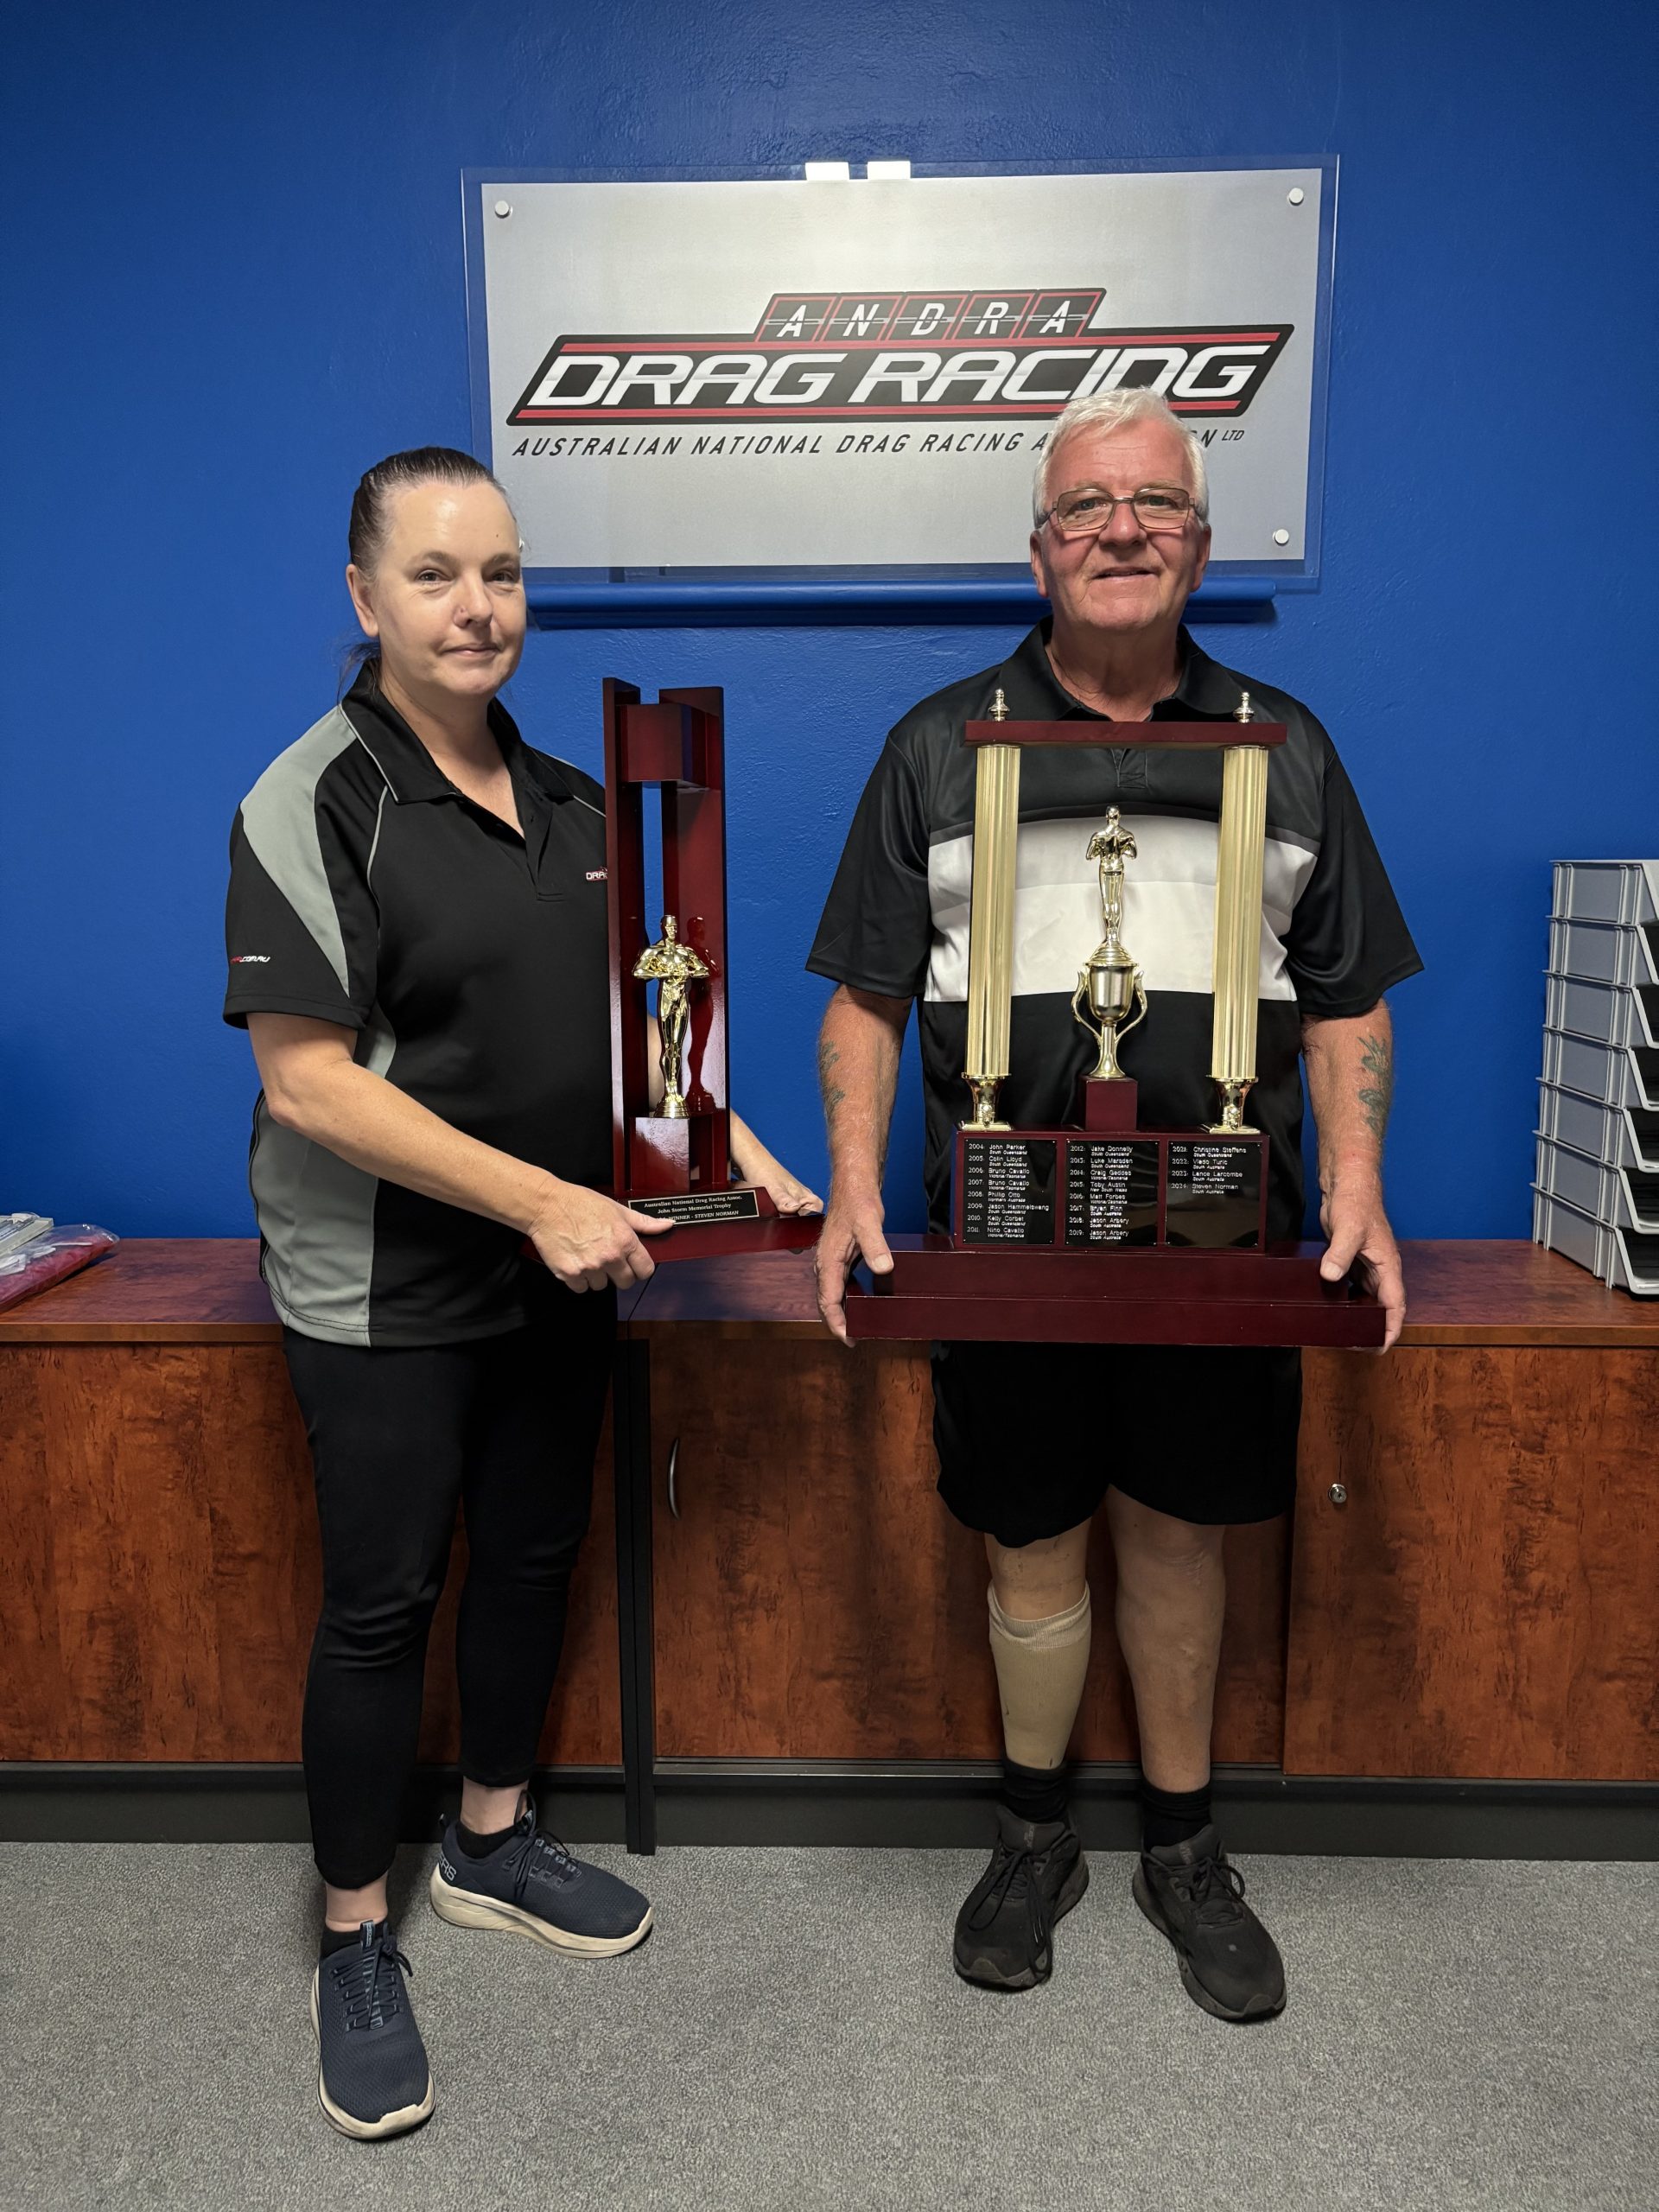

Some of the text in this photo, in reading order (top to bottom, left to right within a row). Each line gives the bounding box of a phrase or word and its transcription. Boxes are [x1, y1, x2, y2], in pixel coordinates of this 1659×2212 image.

[777, 300, 1071, 337] ANDRA
[527, 346, 1270, 406] DRAG RACING
[512, 436, 683, 456] AUSTRALIAN
[690, 435, 823, 455] NATIONAL
[835, 433, 912, 454] DRAG
[919, 432, 1025, 452] RACING
[1222, 429, 1245, 442] LTD
